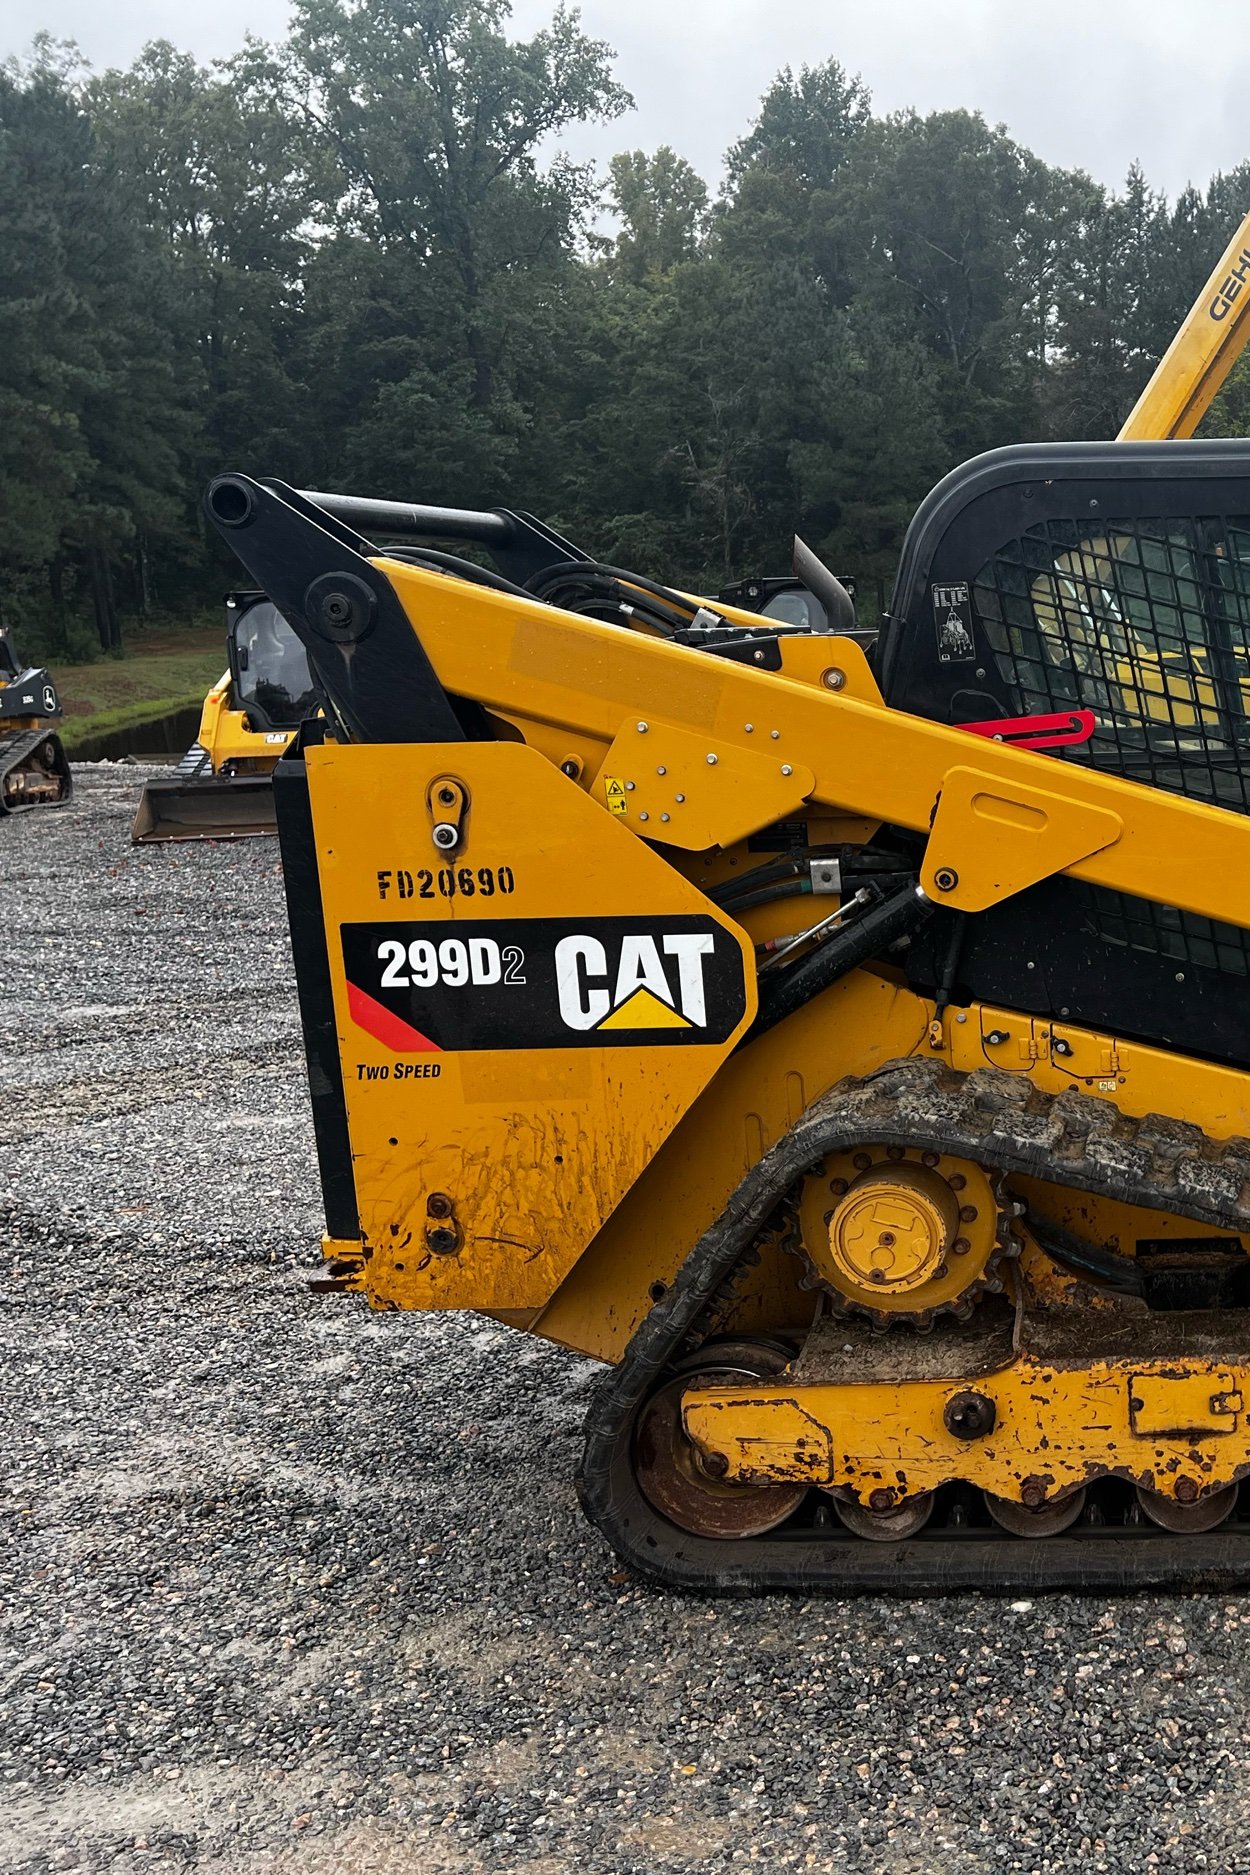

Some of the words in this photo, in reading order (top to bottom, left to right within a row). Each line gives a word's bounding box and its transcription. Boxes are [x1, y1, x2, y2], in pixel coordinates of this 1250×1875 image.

[266, 733, 287, 743] CAT
[377, 866, 516, 899] FD20690
[377, 938, 526, 988] 299D2
[555, 933, 715, 1031] CAT
